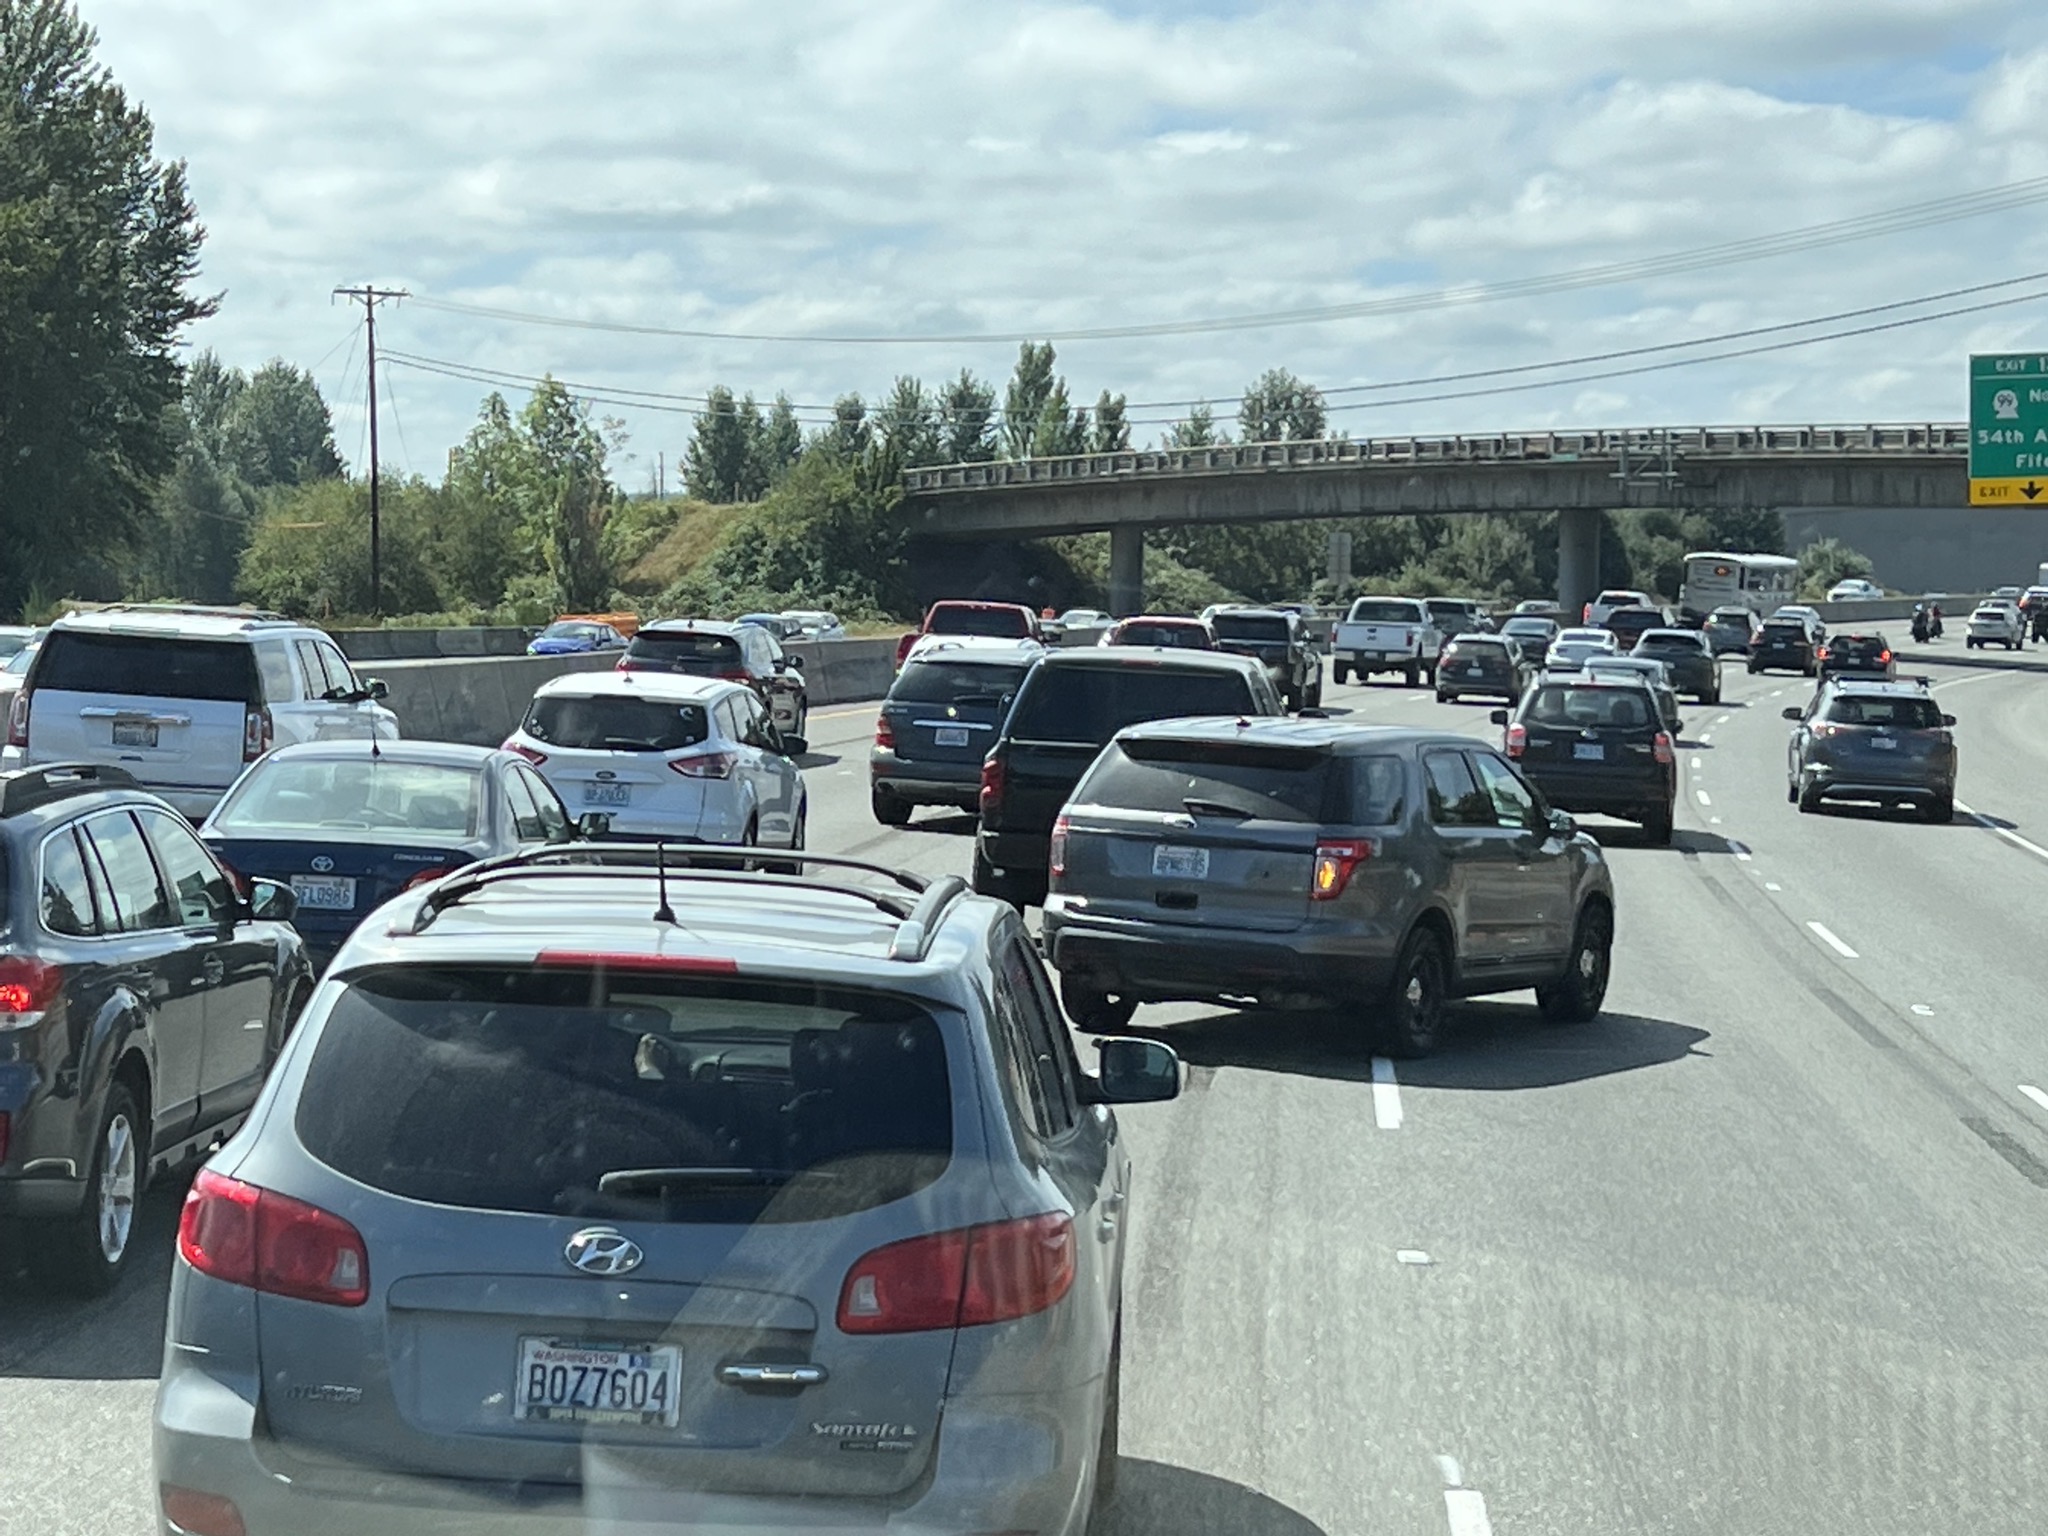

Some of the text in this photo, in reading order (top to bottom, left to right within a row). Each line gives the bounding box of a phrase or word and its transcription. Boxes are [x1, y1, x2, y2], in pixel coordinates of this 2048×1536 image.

[1995, 356, 2048, 372] EXIT 1
[1997, 393, 2014, 408] 99
[1977, 429, 2024, 445] 54th
[1979, 486, 2009, 498] EXIT
[533, 1350, 619, 1365] WASHINGTON
